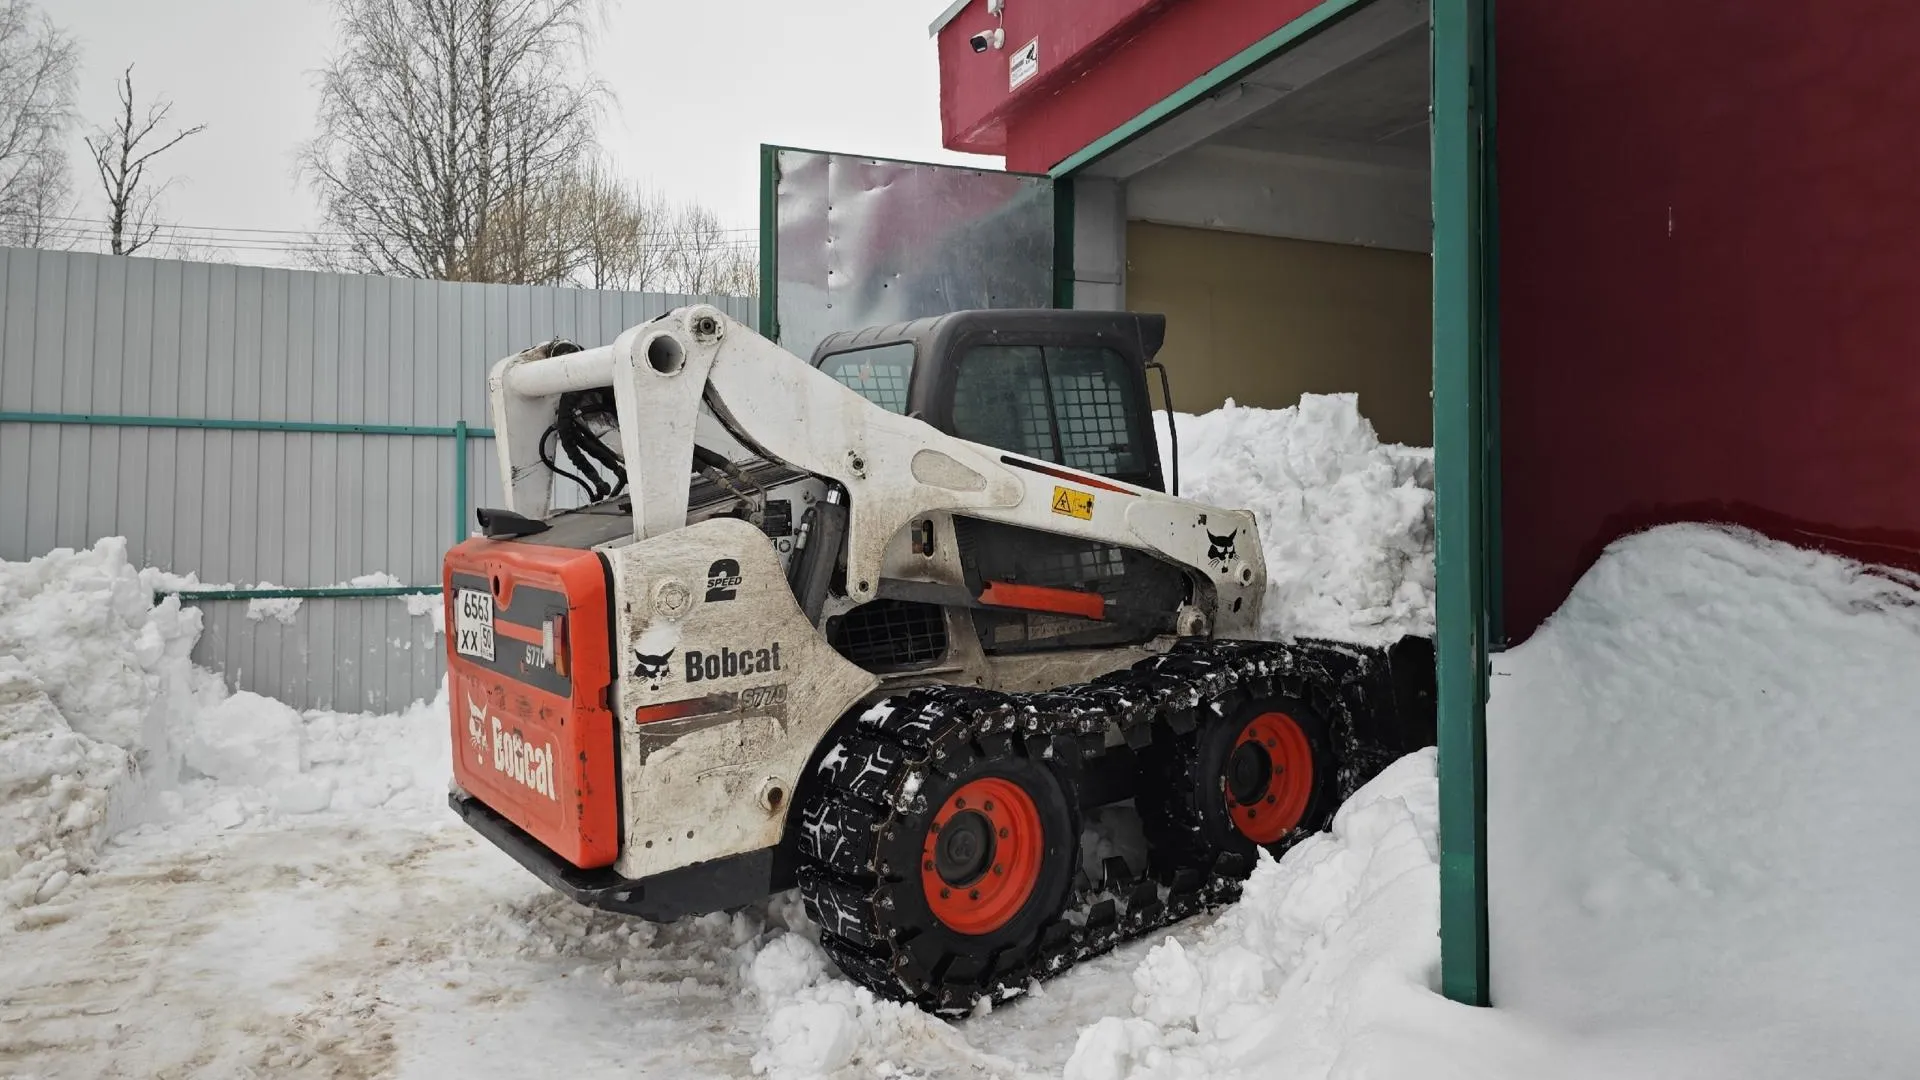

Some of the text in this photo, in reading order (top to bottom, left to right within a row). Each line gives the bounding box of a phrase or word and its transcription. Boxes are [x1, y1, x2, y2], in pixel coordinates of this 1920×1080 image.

[707, 577, 742, 588] SPEED
[464, 593, 489, 622] 6563
[482, 628, 491, 649] 50
[685, 642, 781, 683] Bobcat
[492, 716, 556, 801] Bobcat
